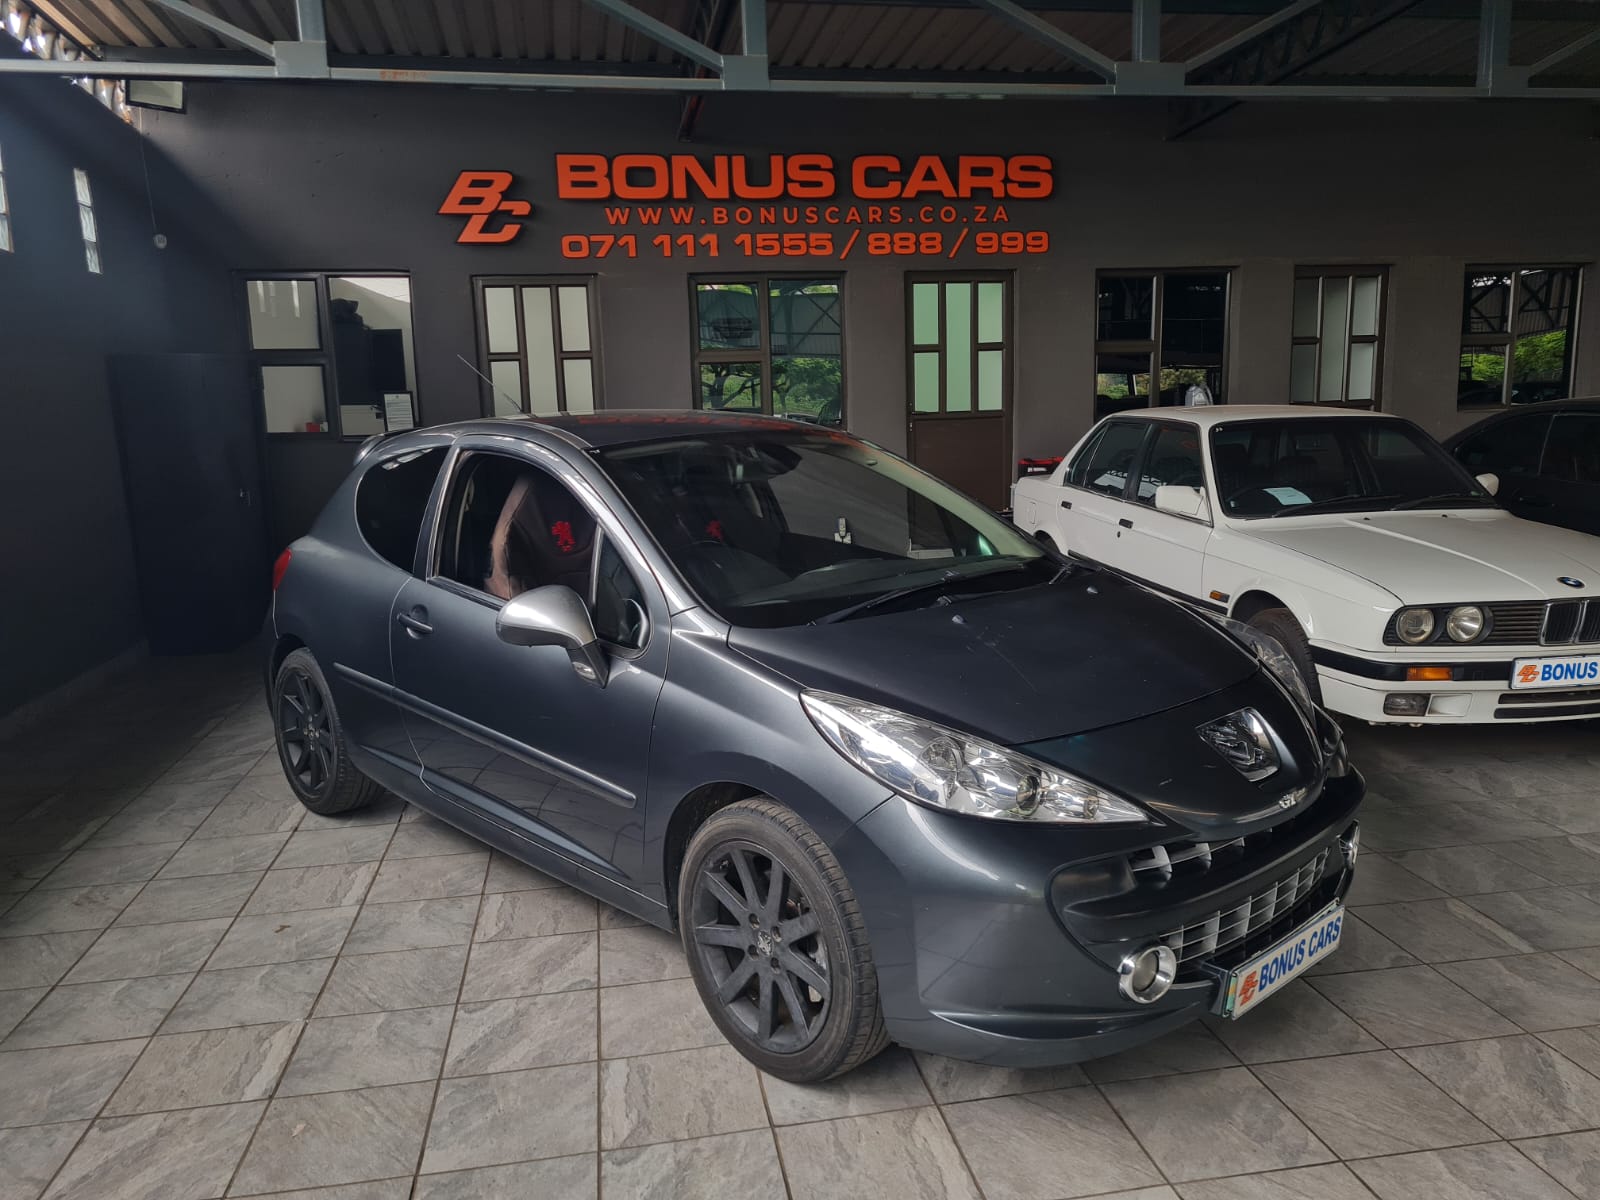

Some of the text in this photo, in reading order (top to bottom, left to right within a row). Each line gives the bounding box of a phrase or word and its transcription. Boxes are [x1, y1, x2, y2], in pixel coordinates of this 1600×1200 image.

[556, 154, 1053, 200] BONUS CARS
[604, 205, 1009, 225] WWW.BONUSCARS.CO.ZA
[561, 234, 637, 259] 071
[652, 233, 719, 258] 111
[1541, 661, 1599, 682] BONUS
[1258, 939, 1306, 992] BONUS
[1308, 916, 1342, 958] CARS
